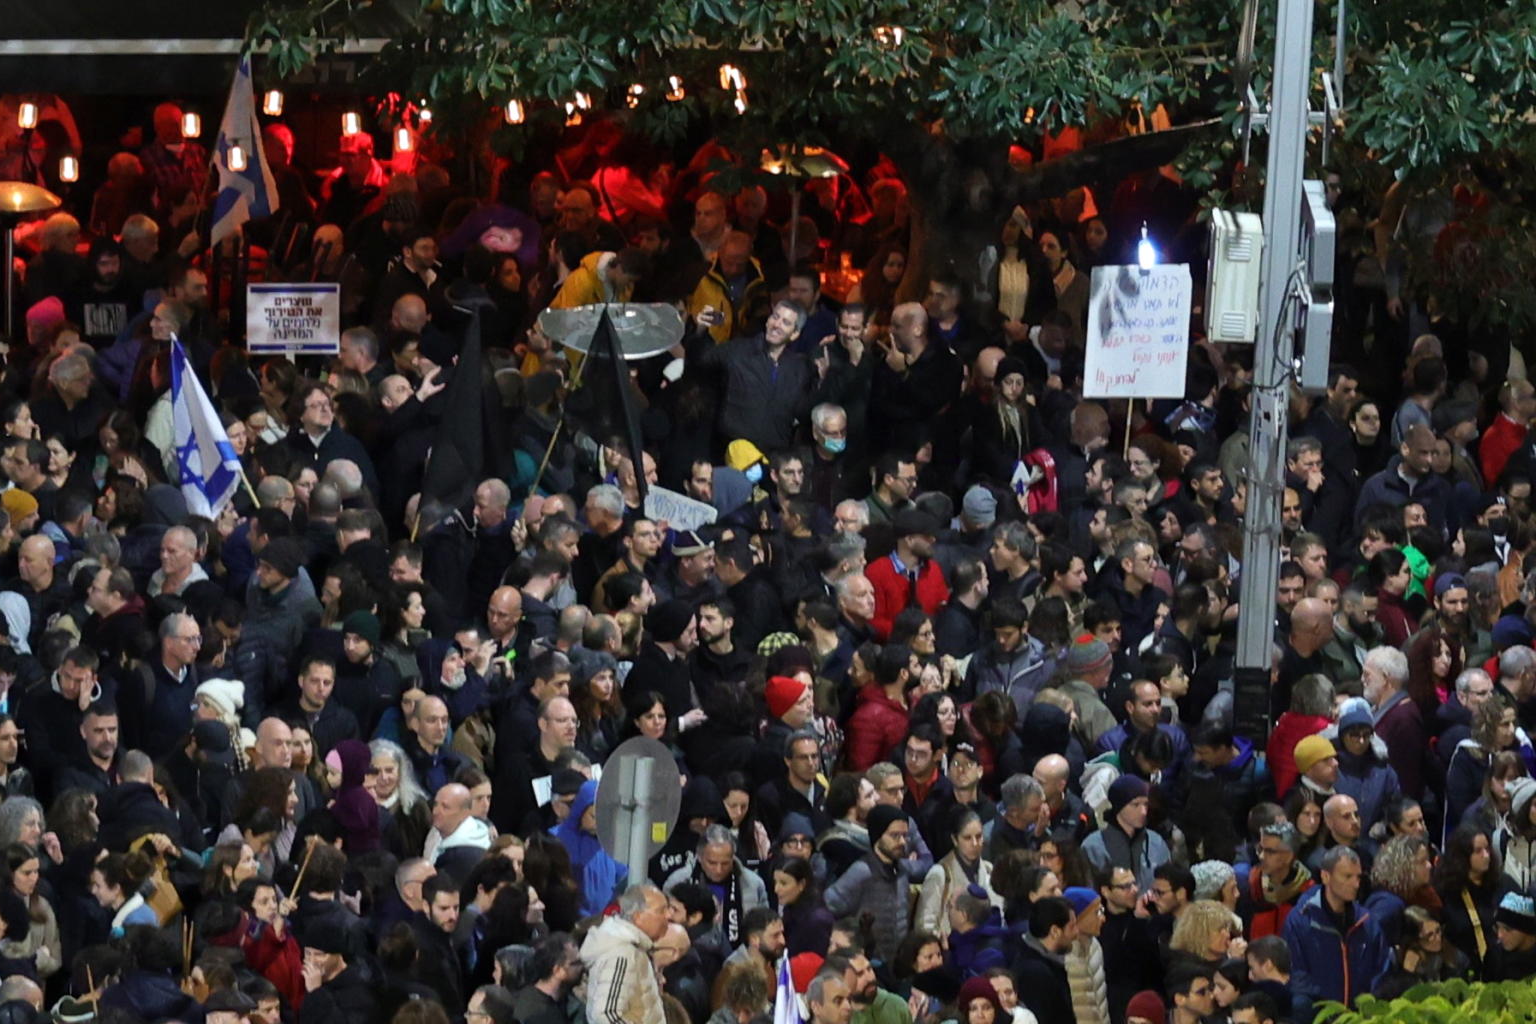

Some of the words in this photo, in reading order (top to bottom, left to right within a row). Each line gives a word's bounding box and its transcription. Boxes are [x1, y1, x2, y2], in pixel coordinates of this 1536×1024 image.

[274, 296, 313, 307] עוצרים
[265, 306, 304, 318] הטירוף
[306, 306, 322, 317] את
[265, 316, 280, 329] על
[282, 317, 321, 329] נלחמים
[273, 328, 314, 340] המדינה
